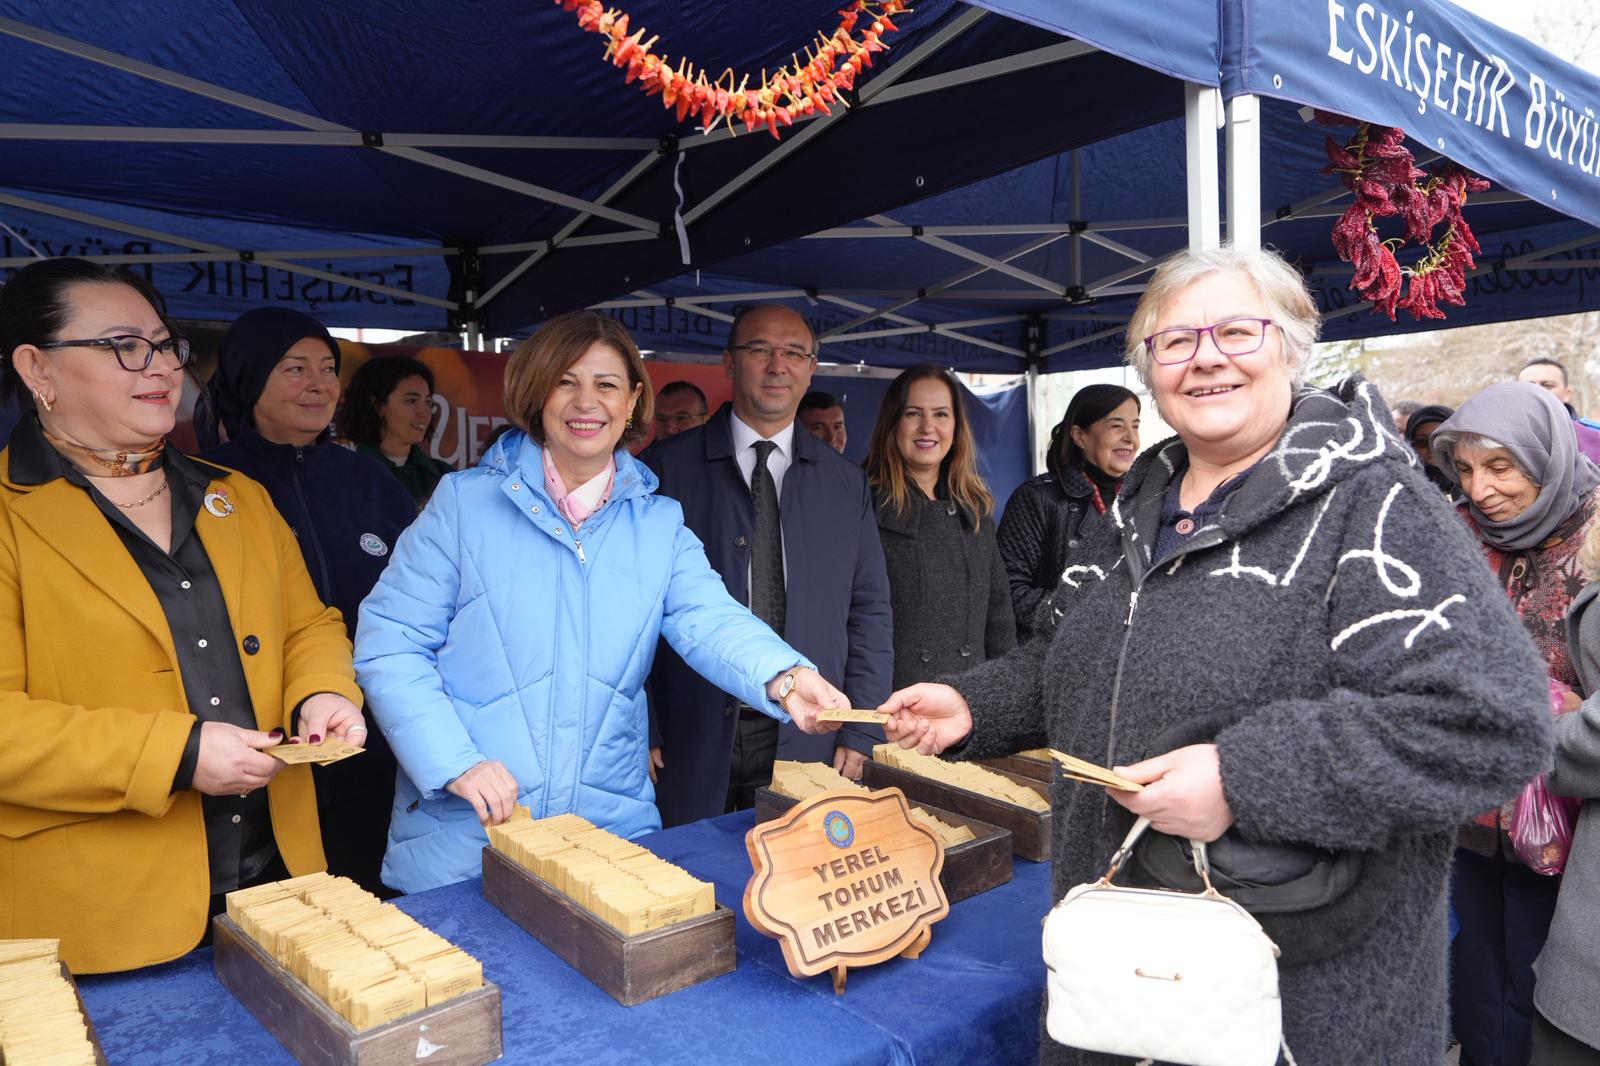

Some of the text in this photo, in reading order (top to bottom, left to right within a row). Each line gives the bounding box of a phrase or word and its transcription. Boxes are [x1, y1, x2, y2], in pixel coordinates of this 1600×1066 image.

[1327, 0, 1516, 138] ESKİŞEHİR
[813, 846, 889, 882] YEREL
[818, 868, 902, 911] TOHUM
[813, 881, 927, 948] MERKEZİ
